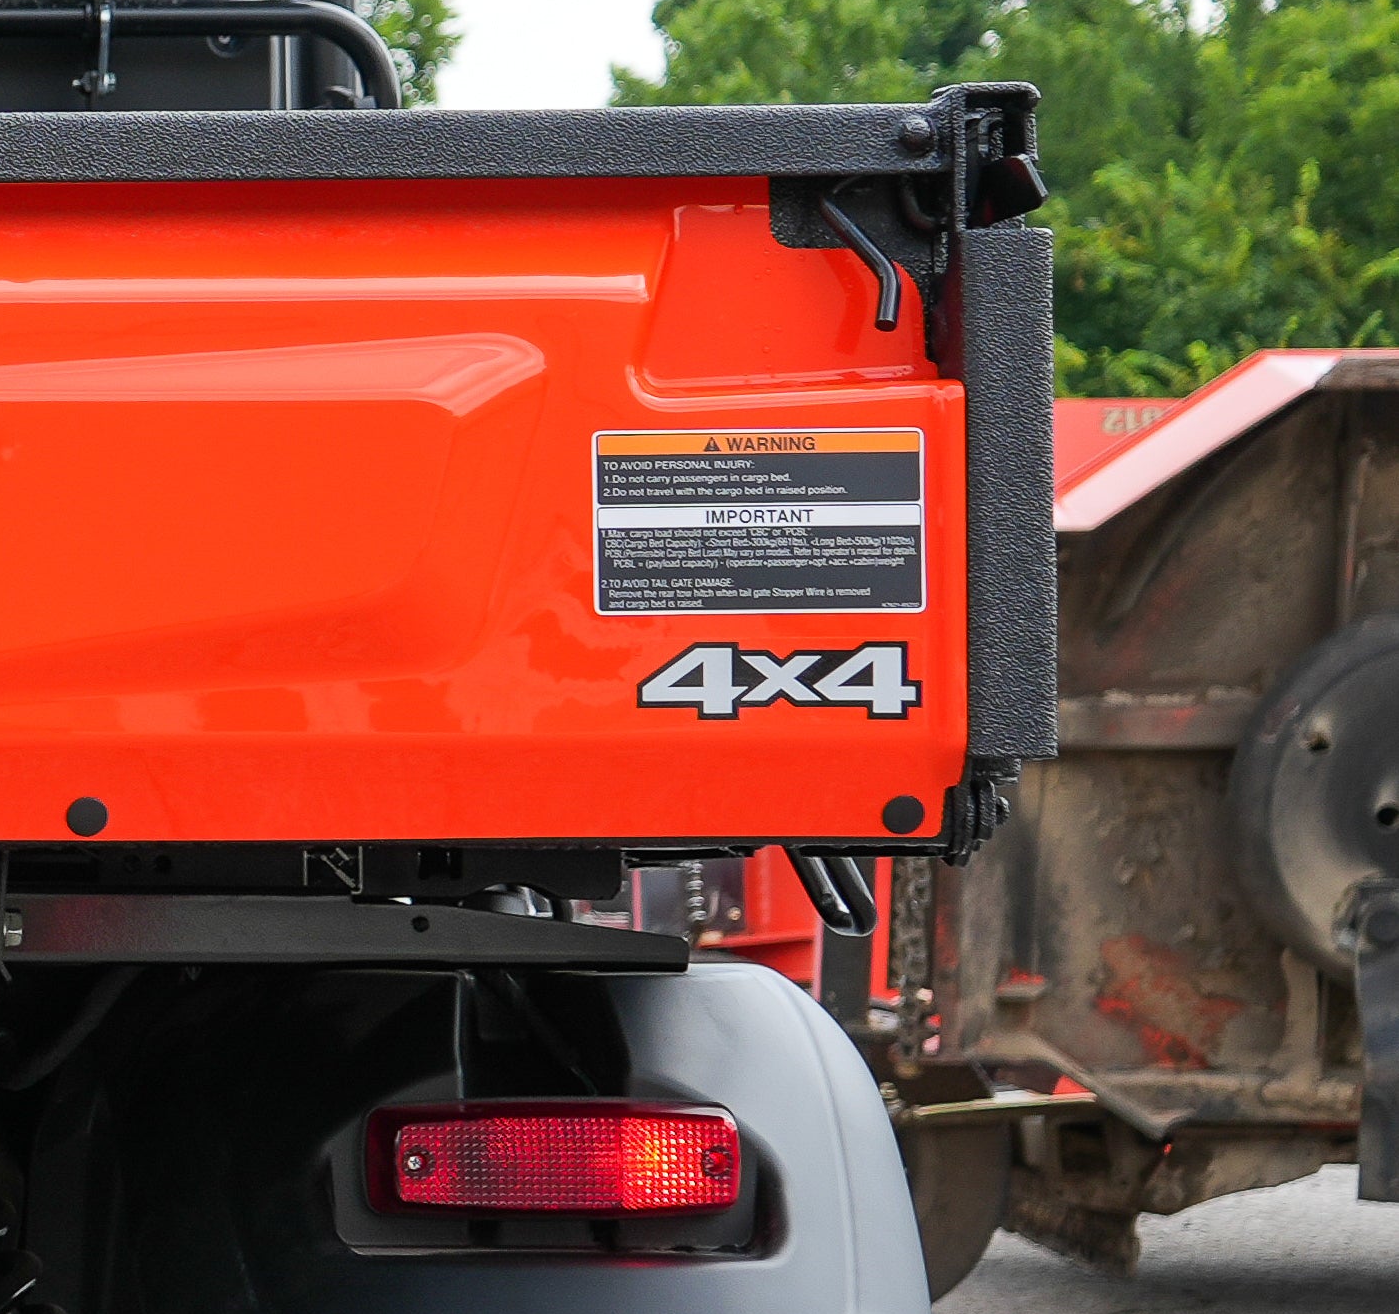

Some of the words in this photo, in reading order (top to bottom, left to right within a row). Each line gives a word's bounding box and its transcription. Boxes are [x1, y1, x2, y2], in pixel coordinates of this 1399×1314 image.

[727, 437, 816, 451] WARNING
[603, 462, 618, 470] TO
[620, 461, 652, 470] AVOID
[655, 461, 712, 469] PERSONAL
[628, 475, 644, 483] not
[646, 476, 670, 484] carry
[673, 475, 728, 484] passengers
[730, 473, 739, 481] in
[741, 474, 768, 483] cargo
[628, 488, 644, 496] not
[697, 487, 713, 495] the
[715, 488, 742, 496] cargo
[744, 486, 763, 494] bed
[765, 486, 774, 494] in
[776, 486, 805, 494] raised
[705, 509, 814, 524] IMPORTANT
[640, 644, 918, 716] 4x4
